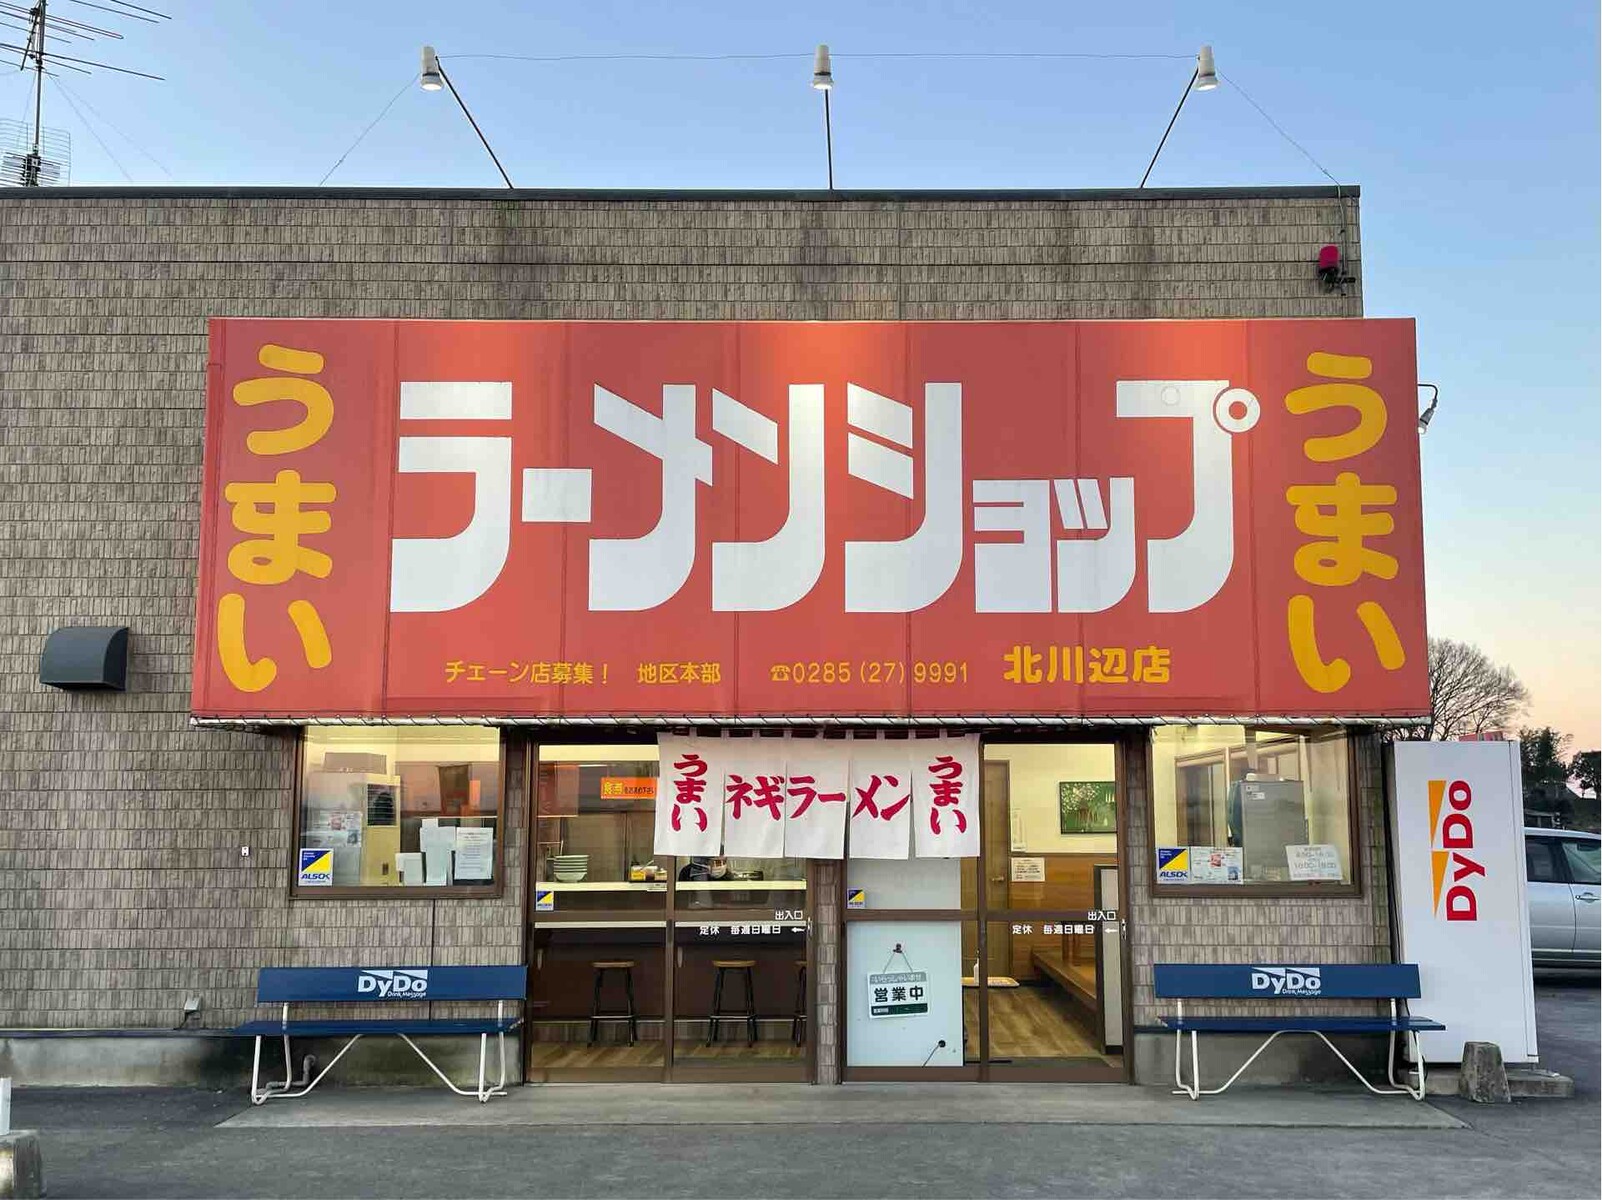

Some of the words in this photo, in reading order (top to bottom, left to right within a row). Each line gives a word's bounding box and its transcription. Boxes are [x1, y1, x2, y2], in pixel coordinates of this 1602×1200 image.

[390, 379, 1261, 614] ラーメンショップ
[217, 344, 337, 693] うまい
[1284, 351, 1406, 694] うまい
[637, 661, 722, 685] 地区本部
[1003, 645, 1171, 685] 北川辺店
[670, 753, 708, 832] うまい
[726, 774, 911, 821] ネギラーメン
[928, 755, 967, 835] うまい
[1442, 780, 1486, 922] DyDo
[699, 925, 720, 935] 定休
[730, 924, 781, 935] 毎週日曜日
[775, 910, 803, 921] 出入口
[1012, 924, 1033, 935] 定休
[1043, 924, 1095, 935] 毎週日曜日
[1088, 910, 1117, 921] 出入口
[358, 975, 428, 998] DyDo
[874, 985, 924, 1003] 営業中
[1251, 972, 1321, 995] DyDo
